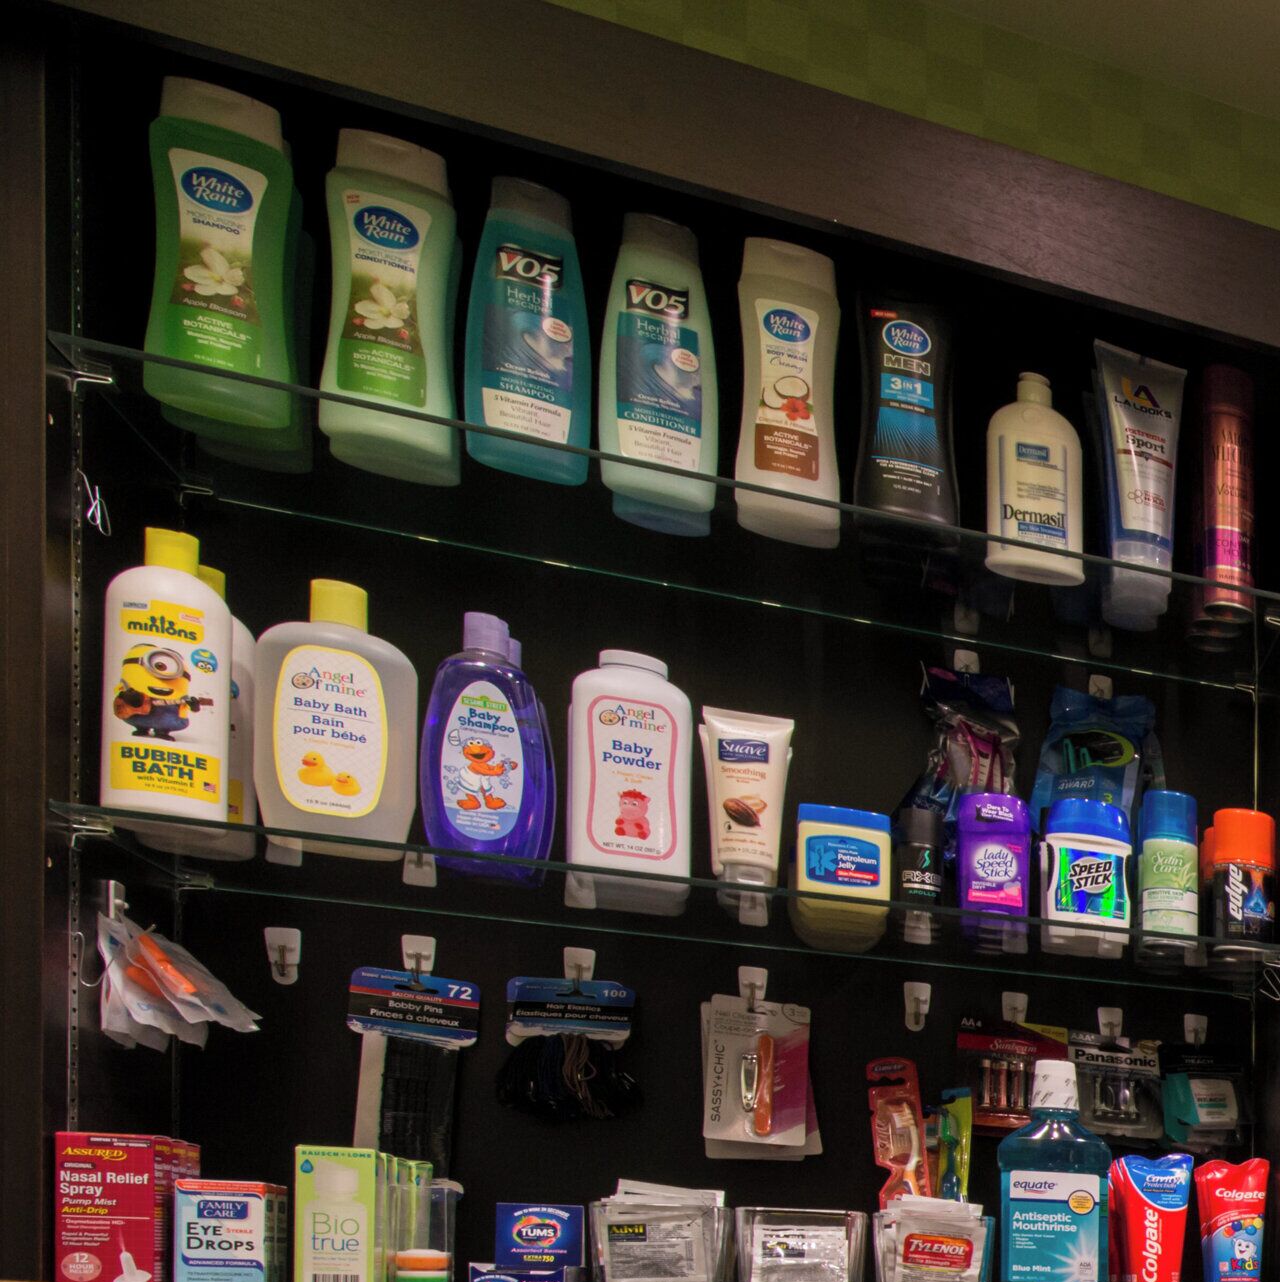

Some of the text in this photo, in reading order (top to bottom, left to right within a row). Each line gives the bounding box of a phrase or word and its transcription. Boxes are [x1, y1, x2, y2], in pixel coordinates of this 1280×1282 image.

[191, 171, 244, 198] White
[194, 187, 238, 208] Rain
[192, 217, 240, 235] SHAMPOO
[362, 211, 412, 235] White
[365, 224, 405, 243] Rain
[629, 285, 685, 314] VO5
[197, 314, 233, 329] ACTIVE
[768, 314, 806, 333] White
[890, 327, 924, 342] White
[884, 354, 931, 376] MEN
[1125, 433, 1166, 457] Sport
[1003, 504, 1067, 528] Dermasil
[127, 616, 198, 642] minions
[308, 666, 354, 684] Angel
[293, 696, 368, 719] Baby Bath
[467, 706, 501, 725] Baby
[615, 704, 656, 721] Angel
[311, 714, 345, 729] Bain
[457, 715, 516, 734] Shampoo
[292, 724, 327, 740] pour
[611, 739, 653, 758] Baby
[720, 739, 768, 758] Suave
[121, 746, 208, 771] BUBBLE
[602, 750, 662, 771] Powder
[131, 760, 194, 781] BATH
[837, 853, 878, 867] Petroleum
[975, 856, 1015, 871] Speed
[1069, 860, 1113, 880] SPEED
[1073, 872, 1113, 893] STICK
[1225, 863, 1248, 921] edge
[448, 983, 473, 1001] 72
[602, 988, 627, 999] 100
[388, 999, 444, 1015] Bobby Pins
[369, 1007, 460, 1028] Pinces cheveux
[588, 1012, 629, 1023] cheveux
[990, 1038, 1037, 1055] Sunbeam
[1074, 1048, 1157, 1069] Panasonic
[60, 1170, 149, 1185] Nasal Relief
[1013, 1179, 1055, 1191] equate
[60, 1182, 103, 1198] Spray
[1215, 1187, 1266, 1201] Colgate
[61, 1197, 118, 1208] Pump Mist
[61, 1206, 109, 1216] Anti-Drip
[200, 1200, 244, 1211] FAMILY
[203, 1207, 238, 1219] CARE
[1012, 1211, 1072, 1224] Antiseptic
[186, 1222, 223, 1237] EYE
[311, 1210, 361, 1236] Bio
[609, 1224, 643, 1235] Advil
[1012, 1221, 1078, 1233] Mouthrinse
[521, 1228, 555, 1238] TUMS
[186, 1235, 255, 1252] DROPS
[310, 1232, 360, 1253] true
[909, 1239, 967, 1256] TYLENOL
[74, 1251, 90, 1264] 12
[1032, 1265, 1051, 1273] Mint
